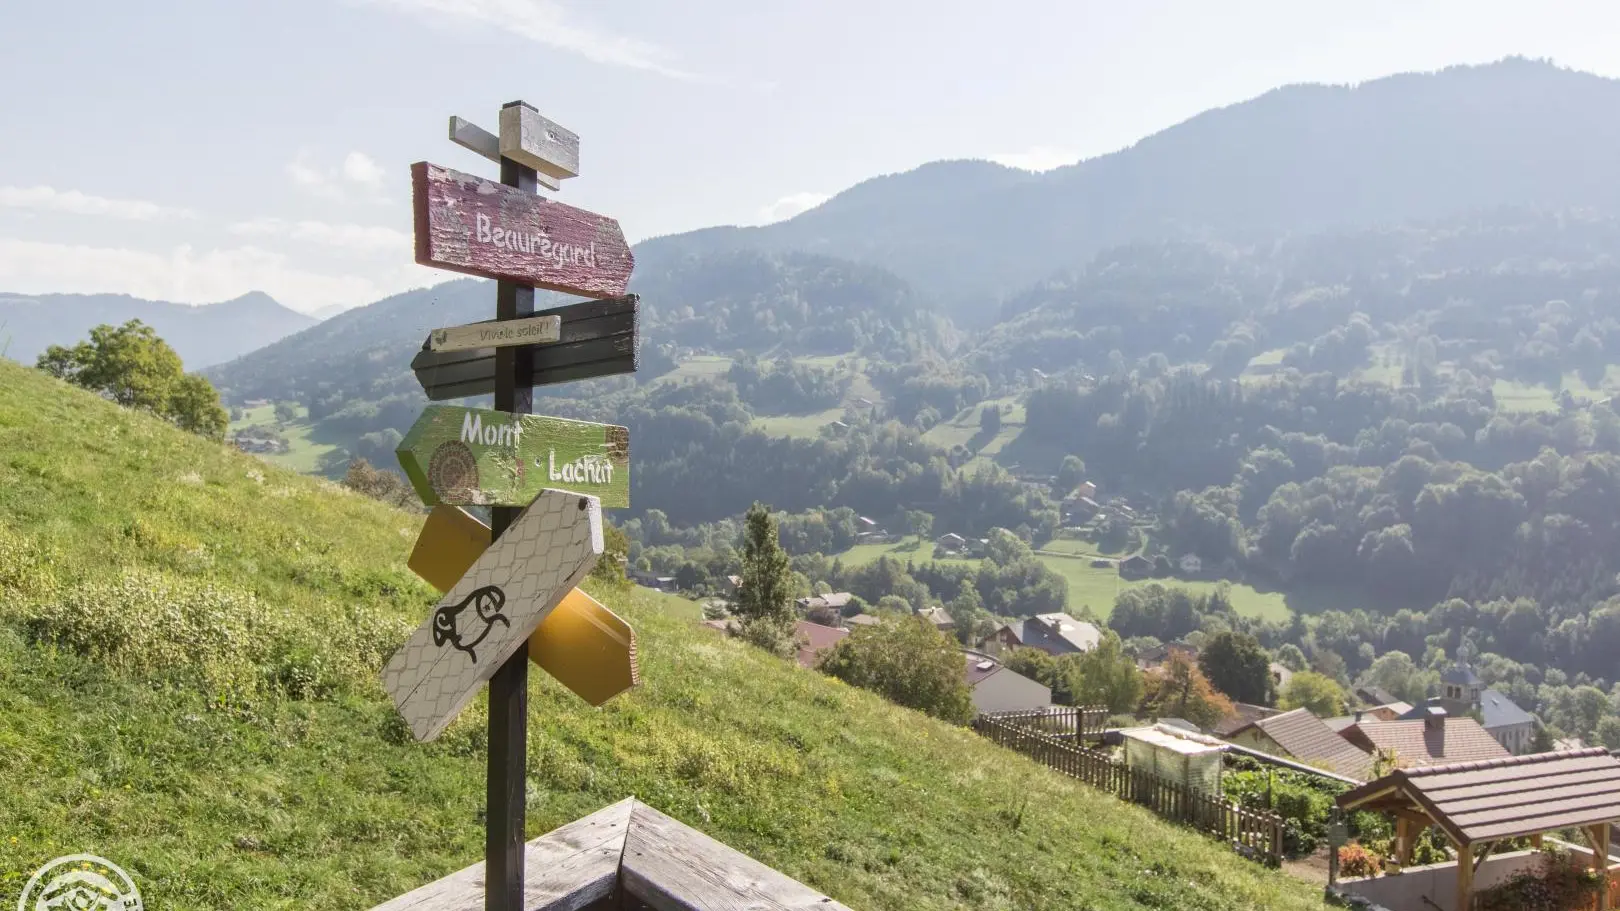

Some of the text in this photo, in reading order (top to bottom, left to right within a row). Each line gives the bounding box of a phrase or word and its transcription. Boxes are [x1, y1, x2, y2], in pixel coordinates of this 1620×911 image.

[476, 212, 596, 269] Beauregard
[460, 411, 523, 449] Mont
[549, 450, 614, 483] Lachat
